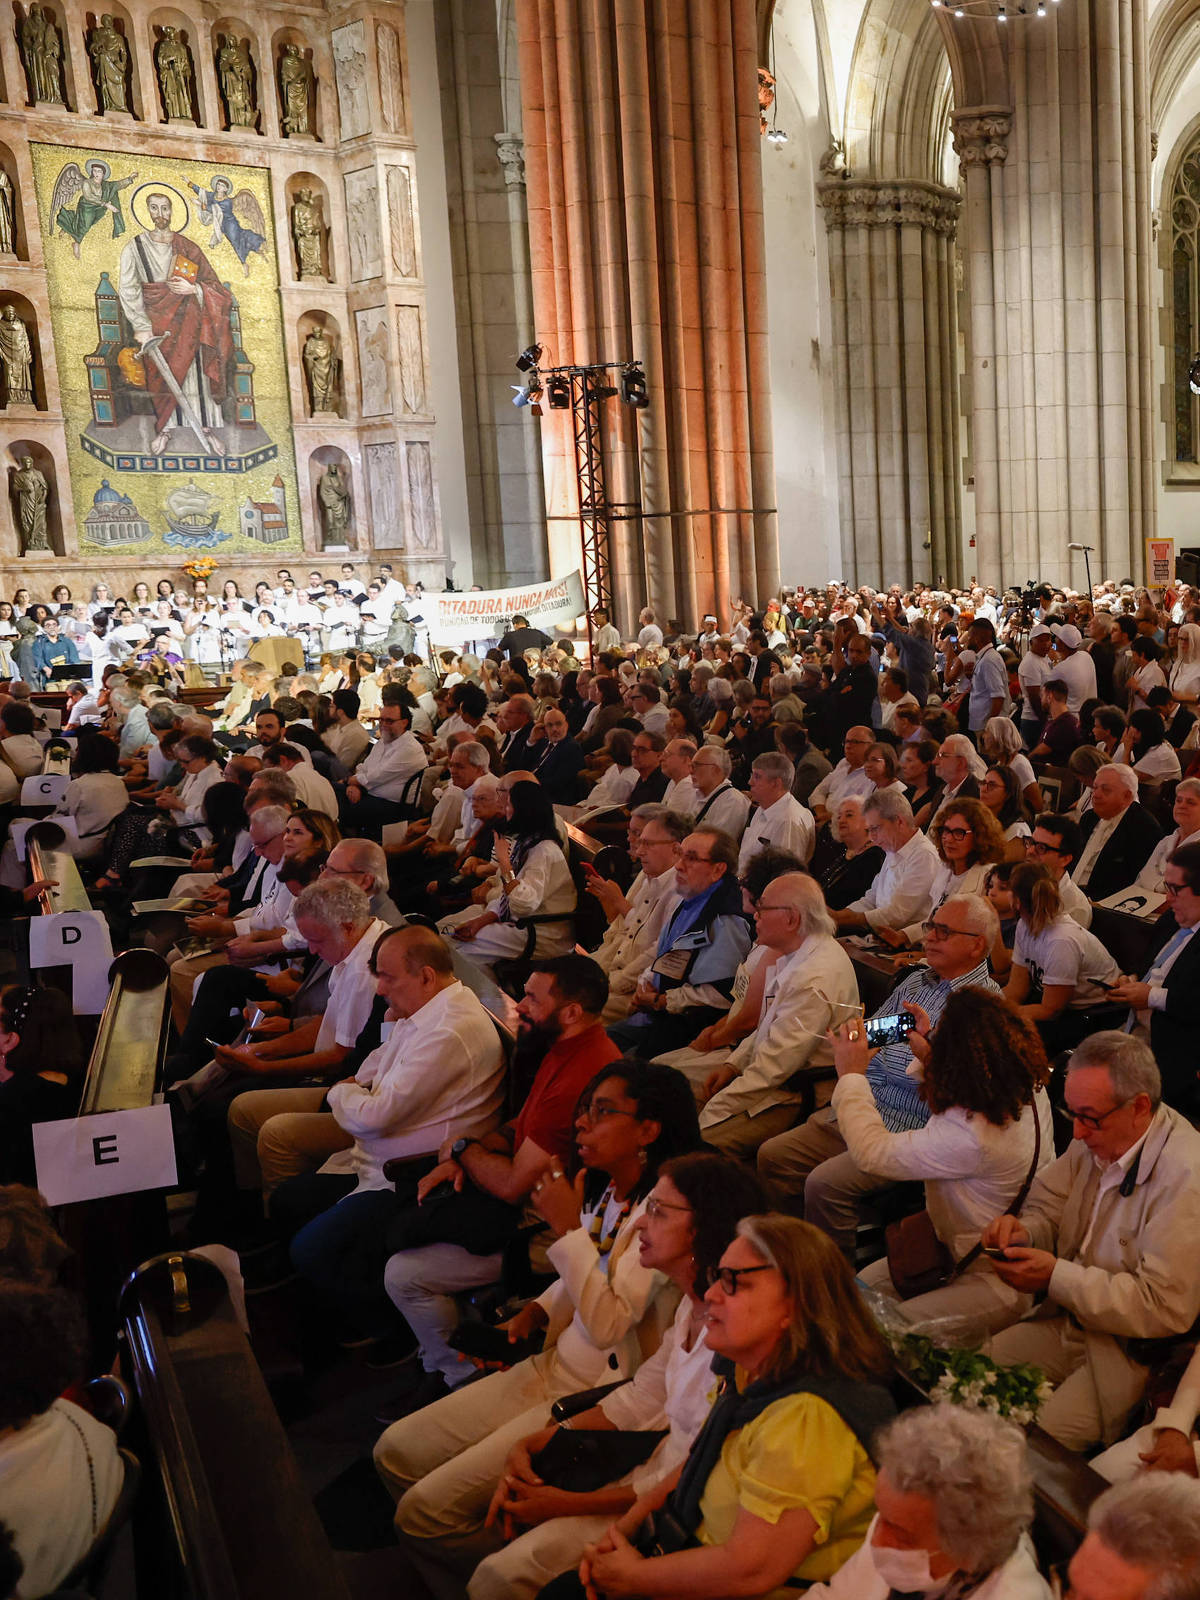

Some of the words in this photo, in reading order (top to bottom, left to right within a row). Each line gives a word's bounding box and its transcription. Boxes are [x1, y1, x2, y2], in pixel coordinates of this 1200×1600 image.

[438, 597, 503, 615] DITADURA
[505, 591, 542, 612] NUNCA
[481, 614, 504, 625] TODOS
[41, 712, 48, 721] A
[39, 782, 52, 794] C
[61, 926, 82, 945] D
[92, 1134, 120, 1166] E
